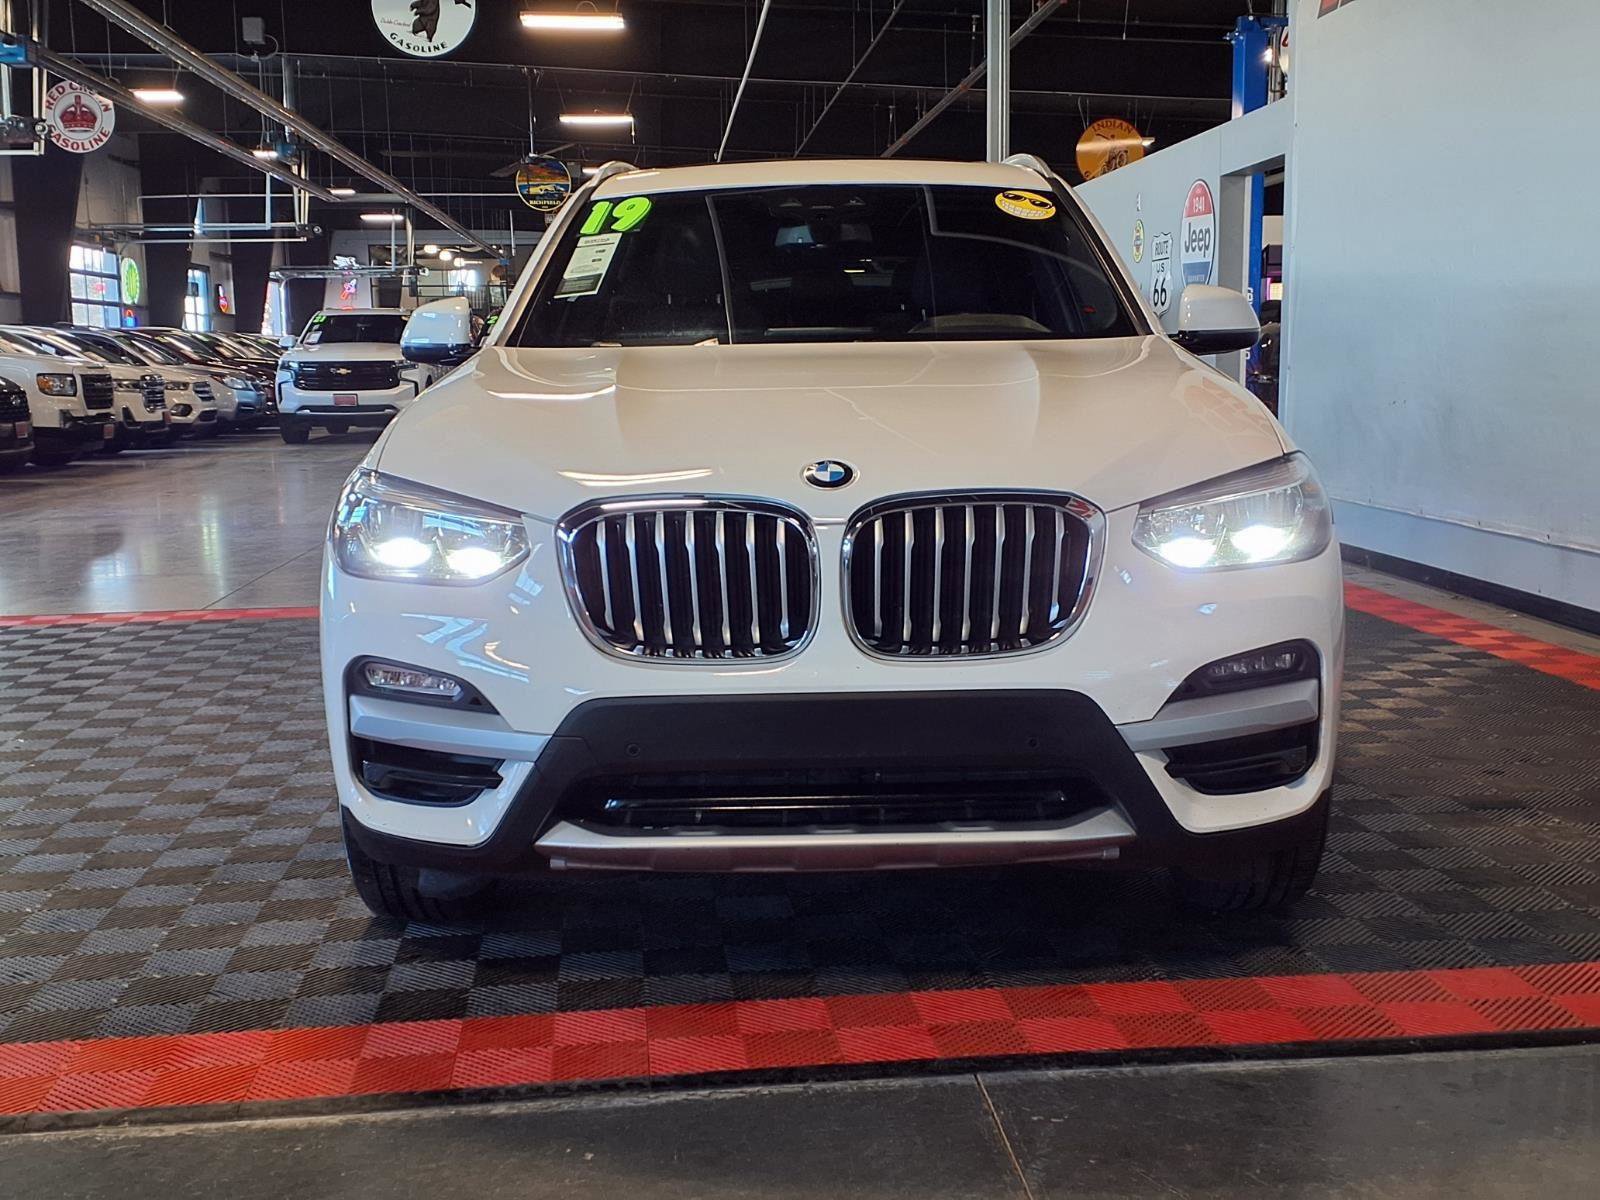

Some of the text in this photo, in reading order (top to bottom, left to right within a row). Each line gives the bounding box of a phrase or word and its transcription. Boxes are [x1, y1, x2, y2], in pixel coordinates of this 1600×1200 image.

[390, 32, 448, 53] GASOLINE
[45, 84, 66, 110] RED
[1092, 120, 1133, 134] INDIAN
[580, 197, 652, 234] 19
[1193, 195, 1205, 213] 1941
[1154, 240, 1169, 256] ROUTE
[1184, 222, 1211, 258] Jeep
[1153, 276, 1167, 307] 66
